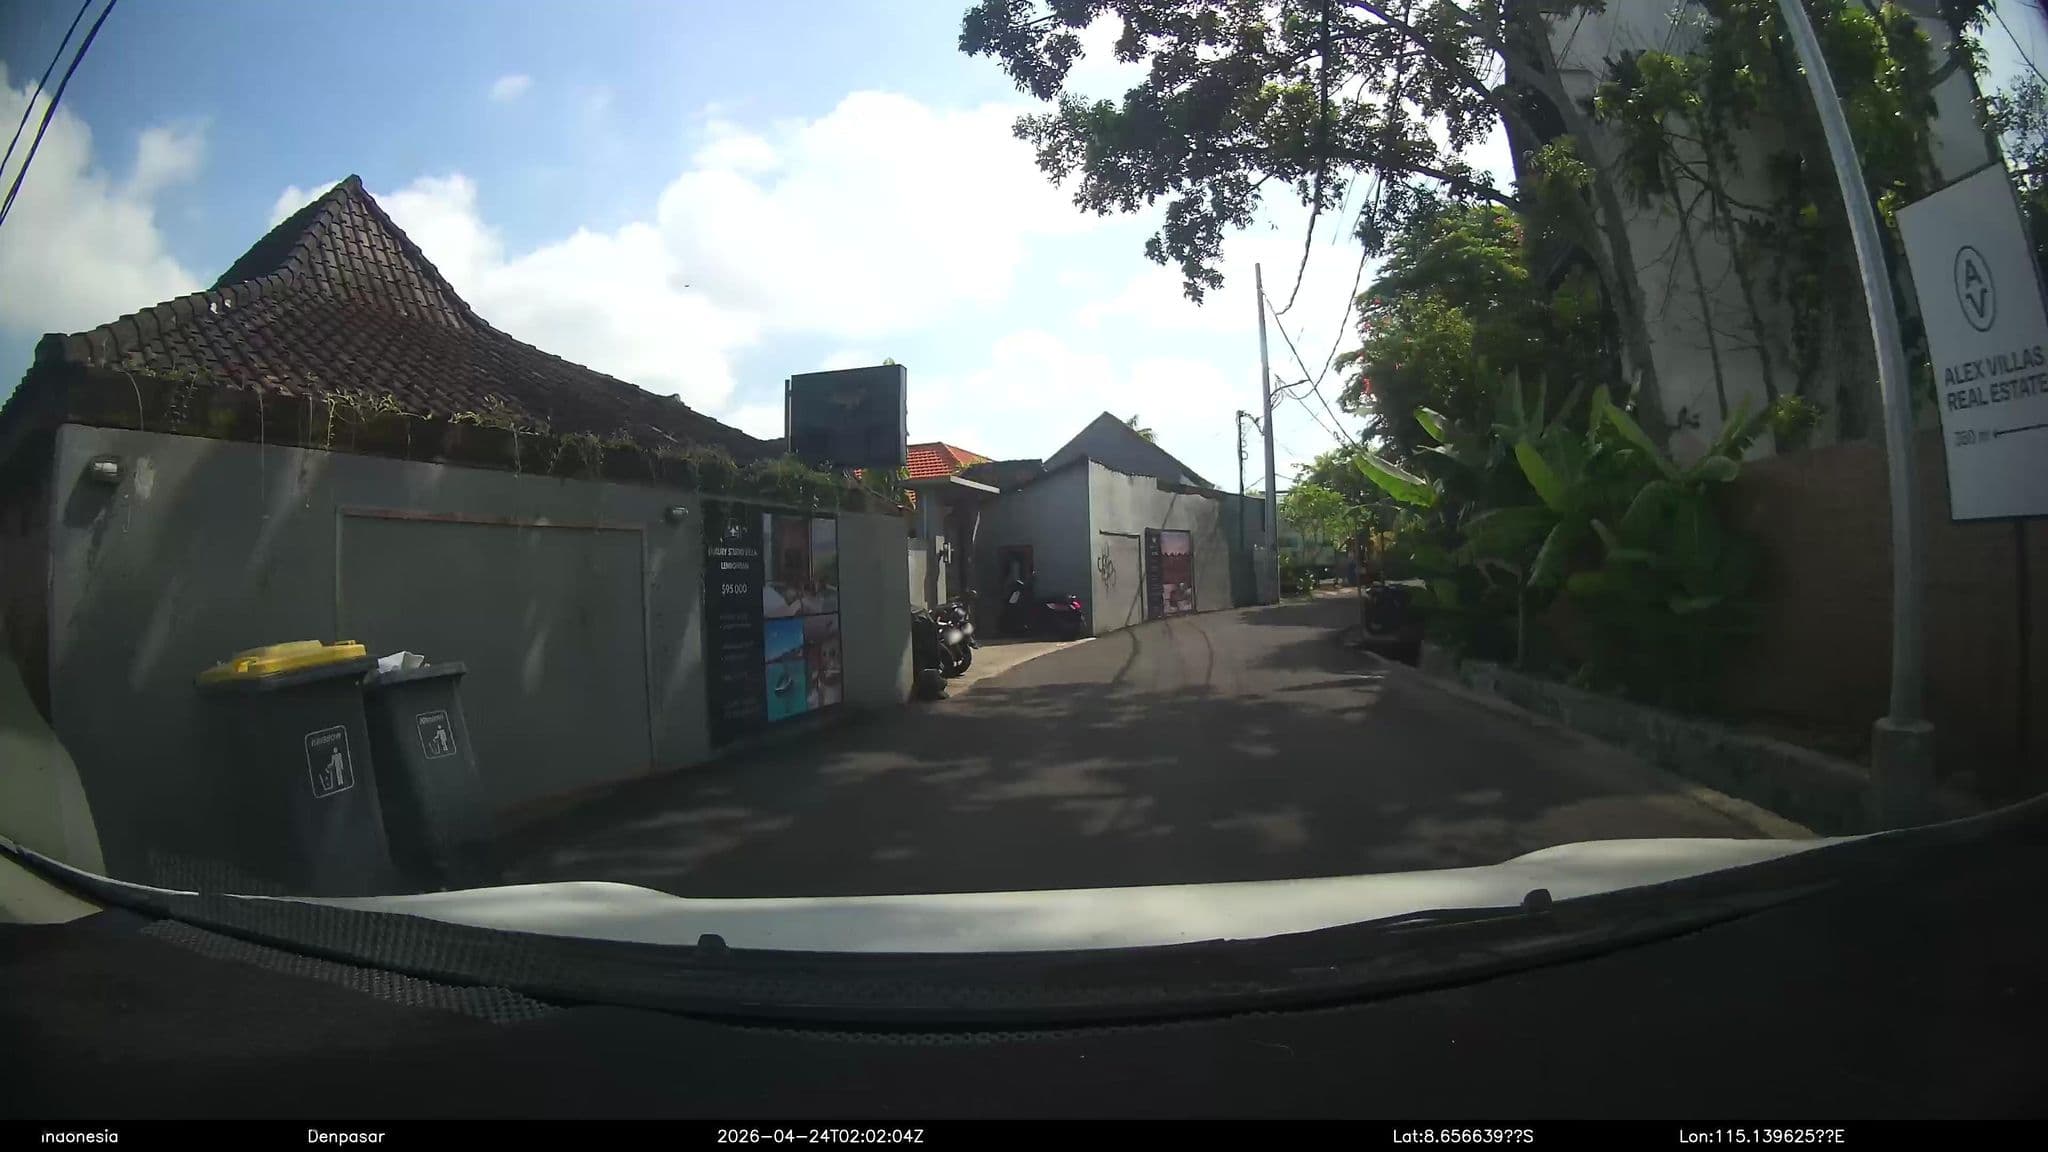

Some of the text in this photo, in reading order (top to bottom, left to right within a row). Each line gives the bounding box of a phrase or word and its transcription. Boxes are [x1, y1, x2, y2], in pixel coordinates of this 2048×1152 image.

[1965, 259, 1983, 288] A
[1965, 287, 1988, 318] V
[1944, 346, 2046, 386] ALEX VILLAS
[1946, 374, 2048, 412] REAL ESTATE
